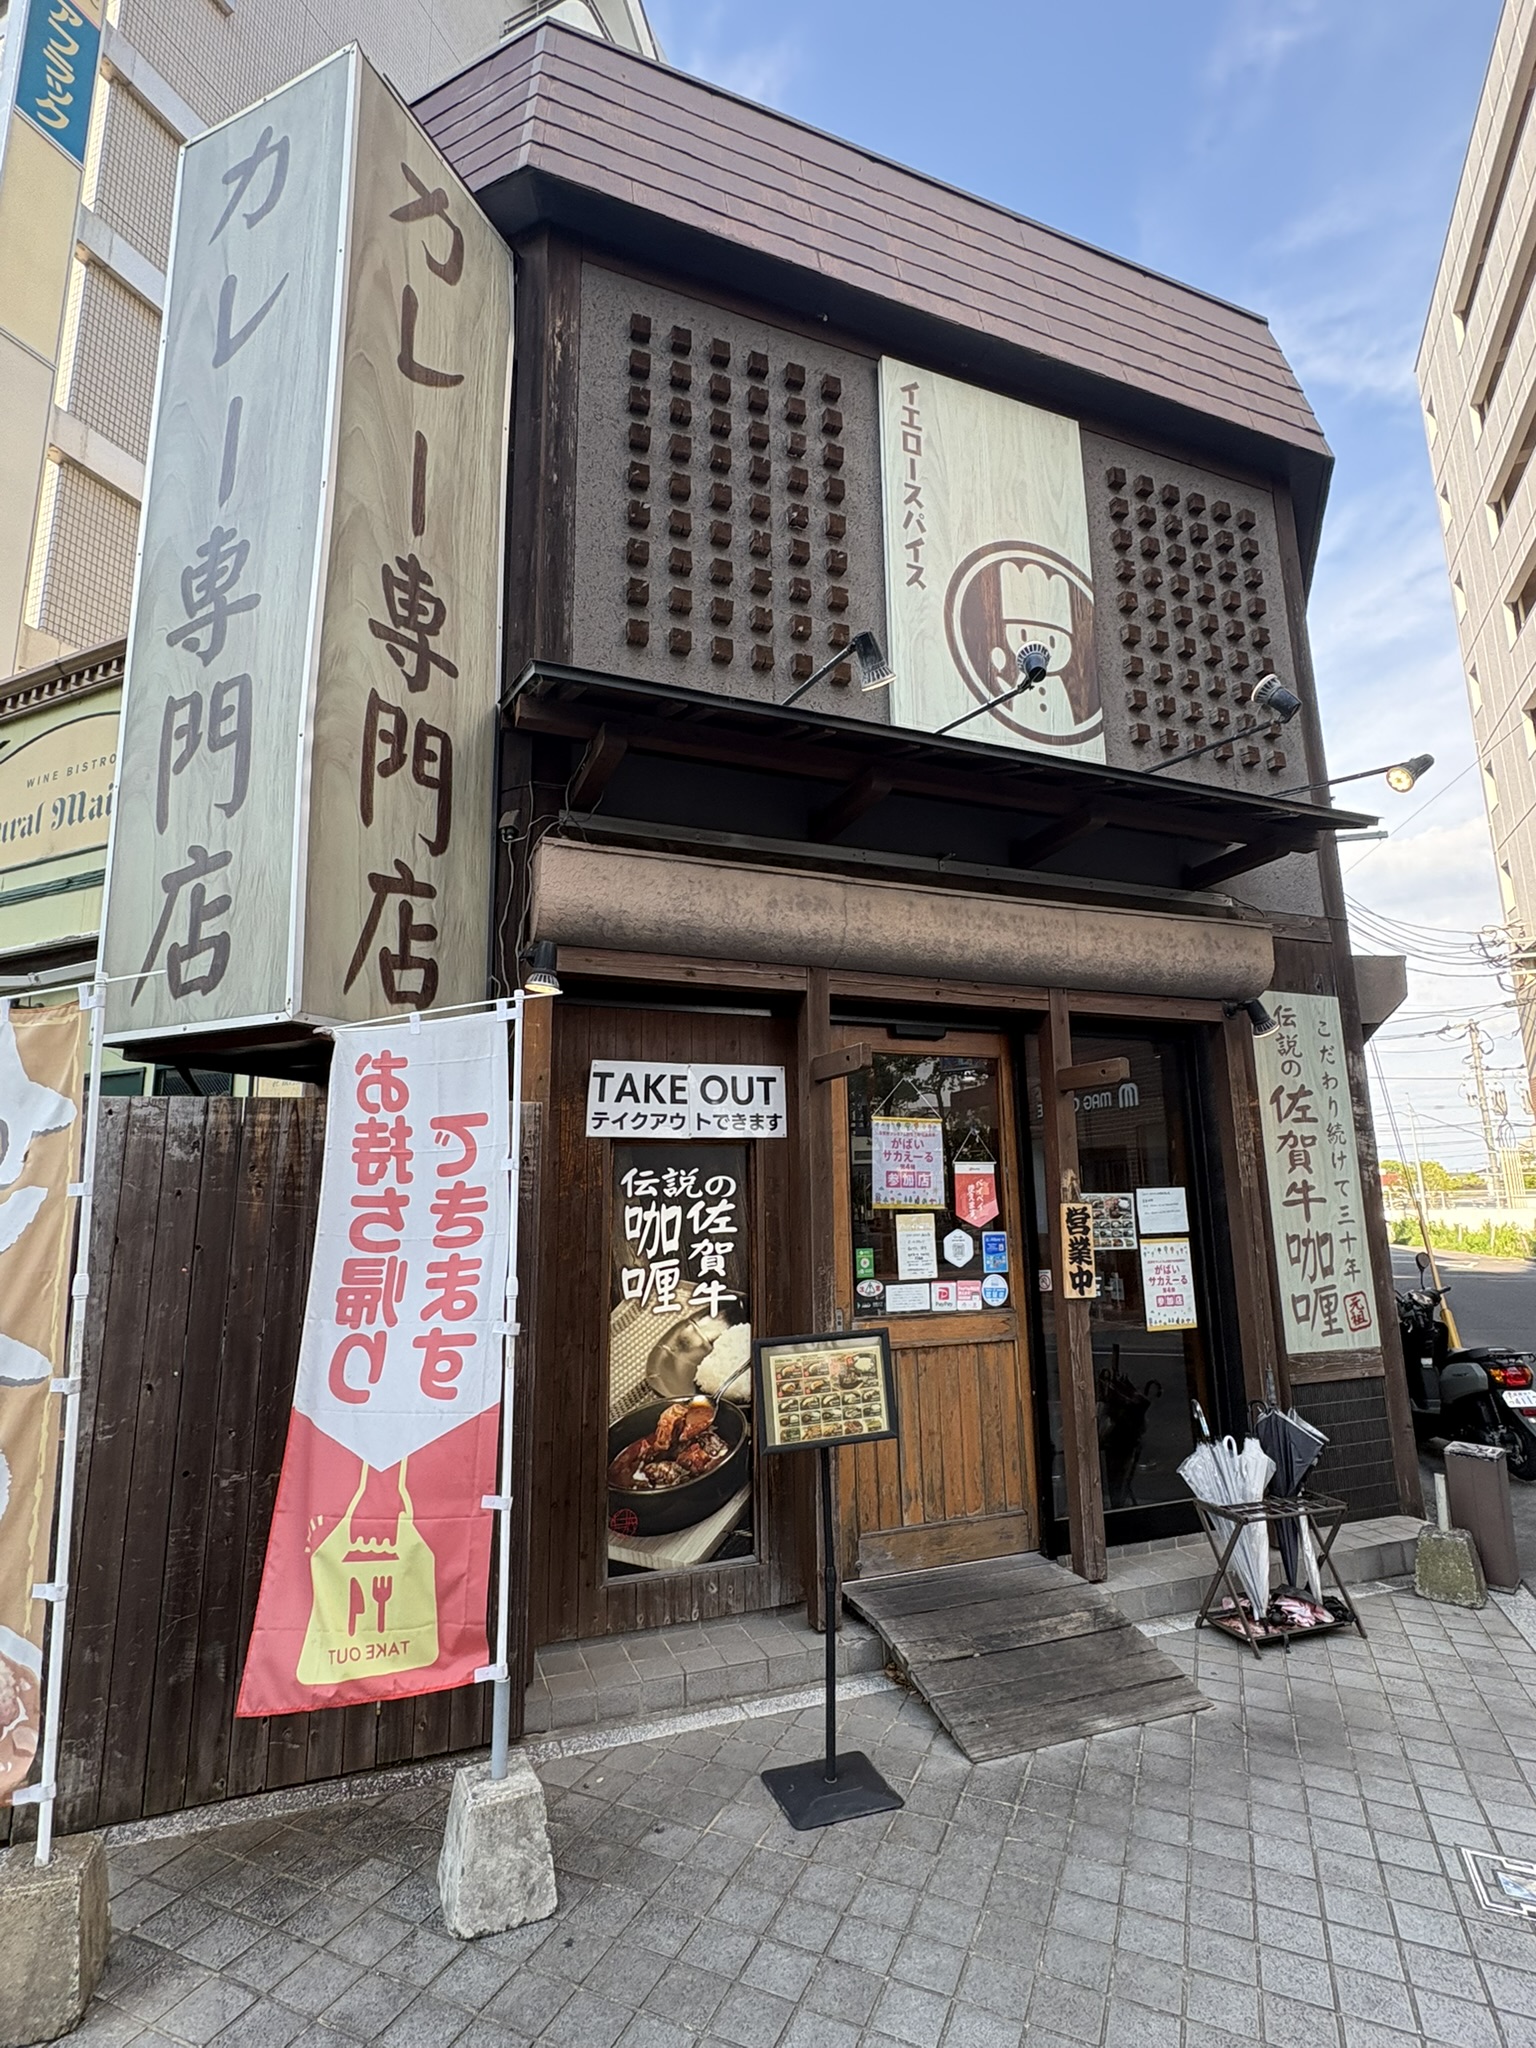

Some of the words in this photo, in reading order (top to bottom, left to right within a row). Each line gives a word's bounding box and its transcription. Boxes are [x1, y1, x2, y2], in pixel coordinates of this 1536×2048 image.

[900, 381, 927, 590] イエロースパイス
[132, 125, 290, 1007] カレー専門店
[344, 162, 465, 1010] カレー専門店
[27, 771, 59, 788] WINE
[66, 753, 117, 777] BISTRO
[593, 1072, 688, 1105] TAKE
[700, 1075, 776, 1106] OUT
[591, 1111, 783, 1132] テイクアウトできます
[891, 1137, 925, 1150] がばい
[1317, 1020, 1361, 1283] こだわり続けて三十年
[620, 1167, 737, 1198] 伝説の
[883, 1150, 934, 1163] サカえーる
[686, 1198, 738, 1318] 佐賀牛
[1066, 1206, 1093, 1296] 営業中
